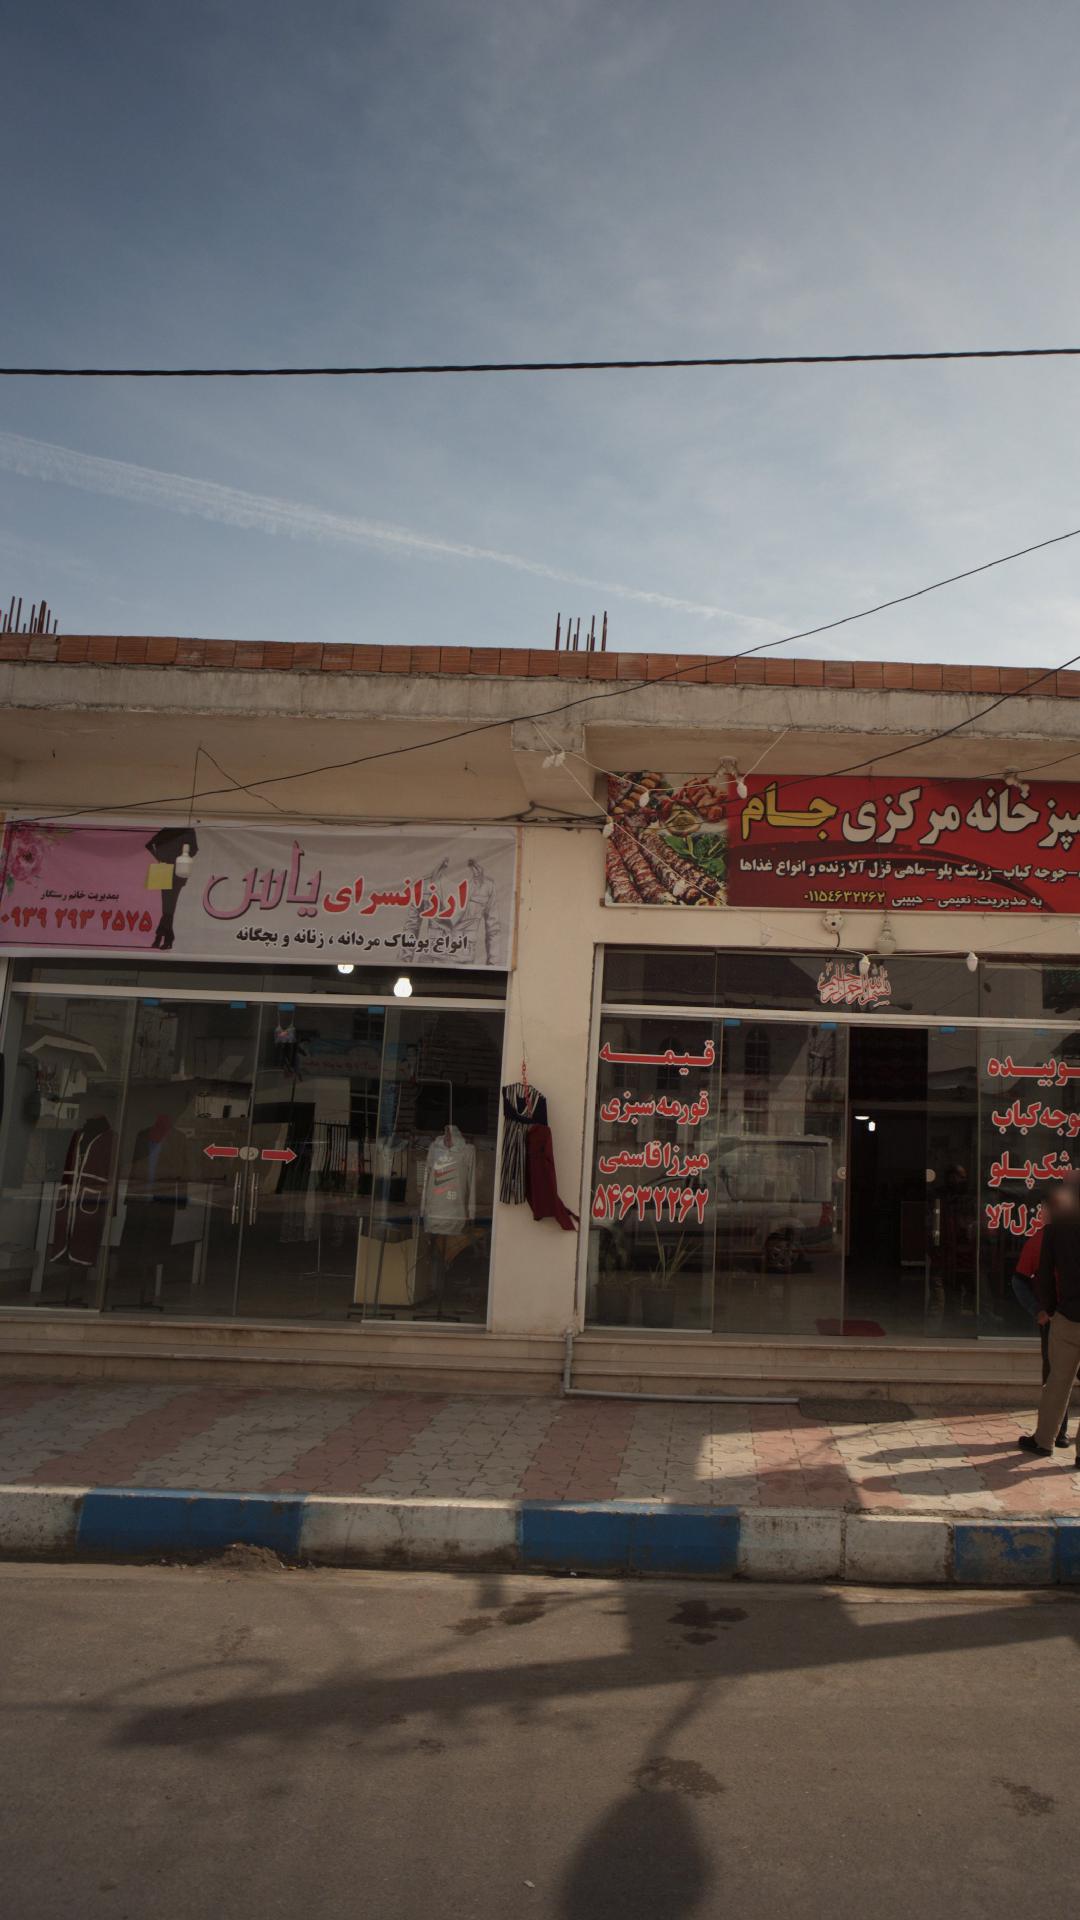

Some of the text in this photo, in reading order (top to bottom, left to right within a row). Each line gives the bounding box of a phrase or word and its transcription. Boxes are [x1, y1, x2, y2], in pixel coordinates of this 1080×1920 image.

[741, 781, 838, 841] جام
[842, 785, 961, 845] مرکزی
[740, 858, 773, 872] غذاها
[775, 860, 806, 876] انواع
[808, 864, 816, 877] و
[818, 861, 846, 878] زنده
[68, 890, 86, 900] خانم
[323, 875, 468, 918] ارزانسرای
[891, 894, 923, 907] حبیبی
[937, 895, 971, 908] نعیمی
[1029, 896, 1043, 907] به
[236, 927, 278, 947] بچگانه
[281, 934, 290, 947] و
[294, 929, 324, 948] زنانه
[338, 930, 380, 950] مردانه
[384, 933, 429, 952] پوشاک
[433, 935, 467, 952] انواع
[600, 1039, 715, 1075] قیمه
[987, 1055, 1080, 1086] وبیده
[992, 1100, 1041, 1135] کباب
[988, 1151, 1032, 1189] پلو
[592, 1184, 709, 1224] ۵۴۶۳۲۲۶۲
